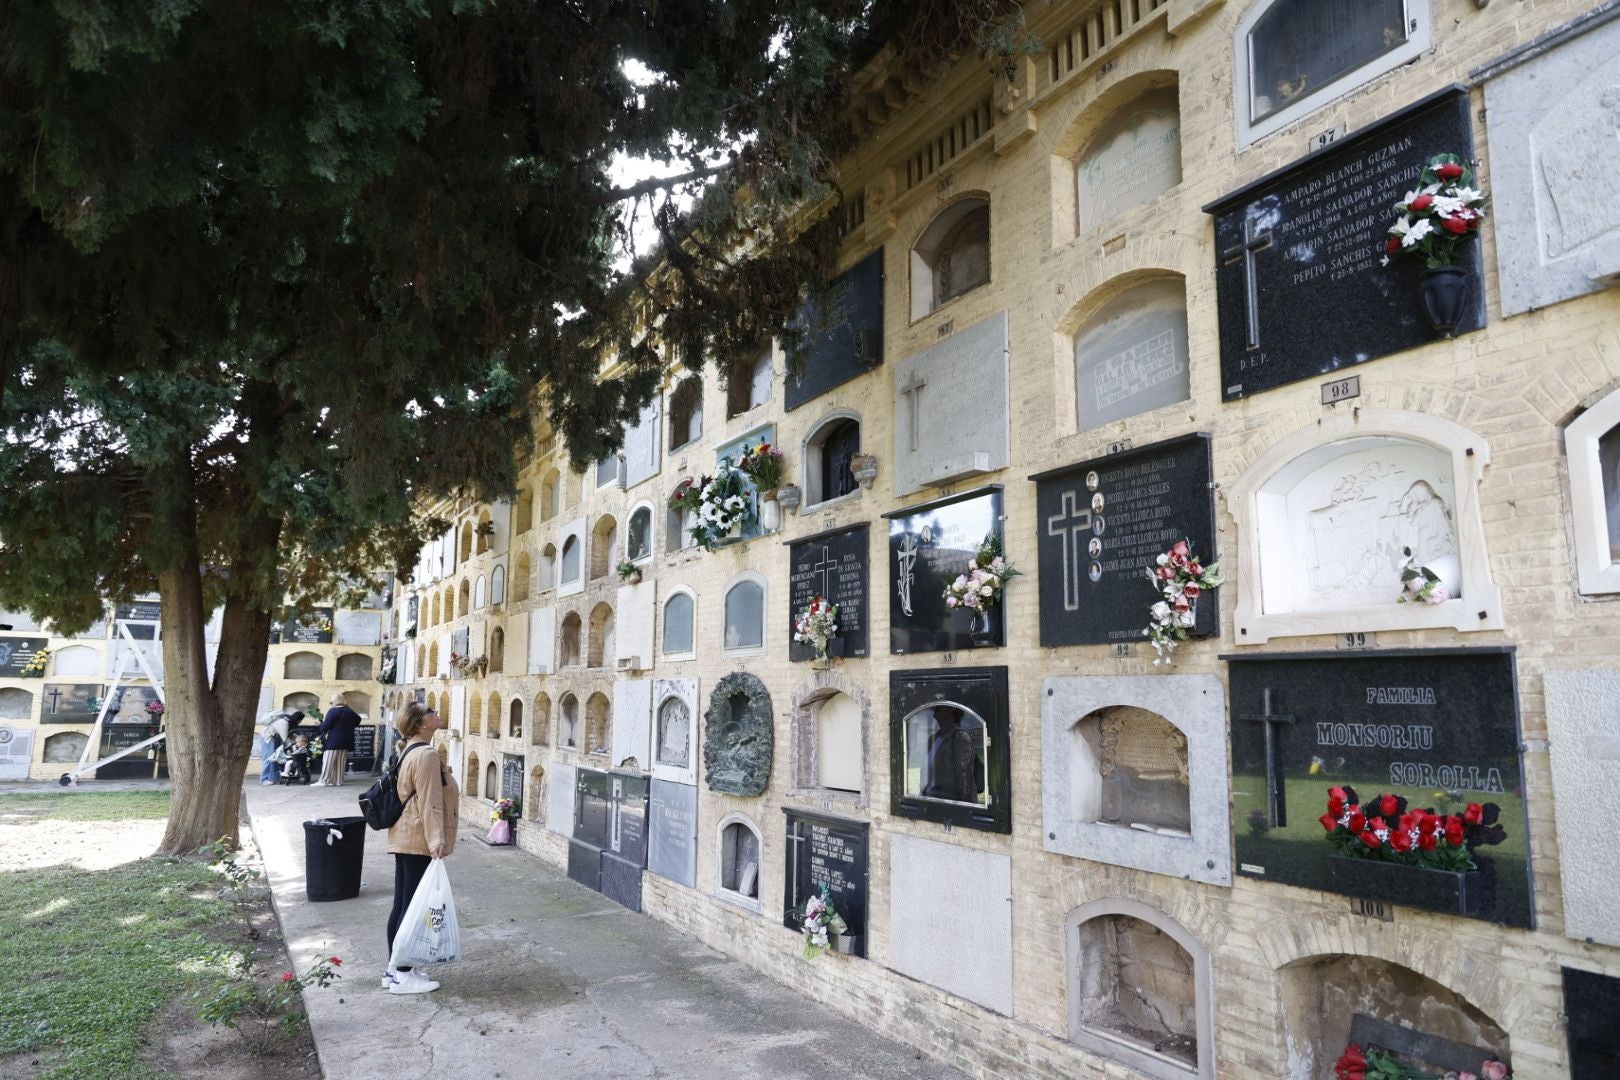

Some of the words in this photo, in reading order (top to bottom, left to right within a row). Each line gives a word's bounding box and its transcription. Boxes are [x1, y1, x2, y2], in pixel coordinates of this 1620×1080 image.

[1319, 130, 1336, 148] 97
[1284, 179, 1321, 204] AMPARO
[1325, 159, 1363, 187] BLANCH
[1368, 136, 1412, 166] GUZMAN
[1282, 208, 1322, 234] MANOLIN
[1325, 185, 1373, 214] SALVADOR
[1377, 164, 1421, 191] SANCHIS
[1327, 214, 1375, 244] SALVADOR
[1293, 263, 1326, 285] PEPITO
[1330, 245, 1371, 271] SANCHIS
[1331, 383, 1350, 399] 98
[1346, 632, 1366, 647] 99
[1366, 687, 1437, 704] FAMILIA
[1316, 722, 1433, 750] MONSORIU
[1390, 762, 1505, 793] SOROLLA
[1359, 899, 1385, 918] 100
